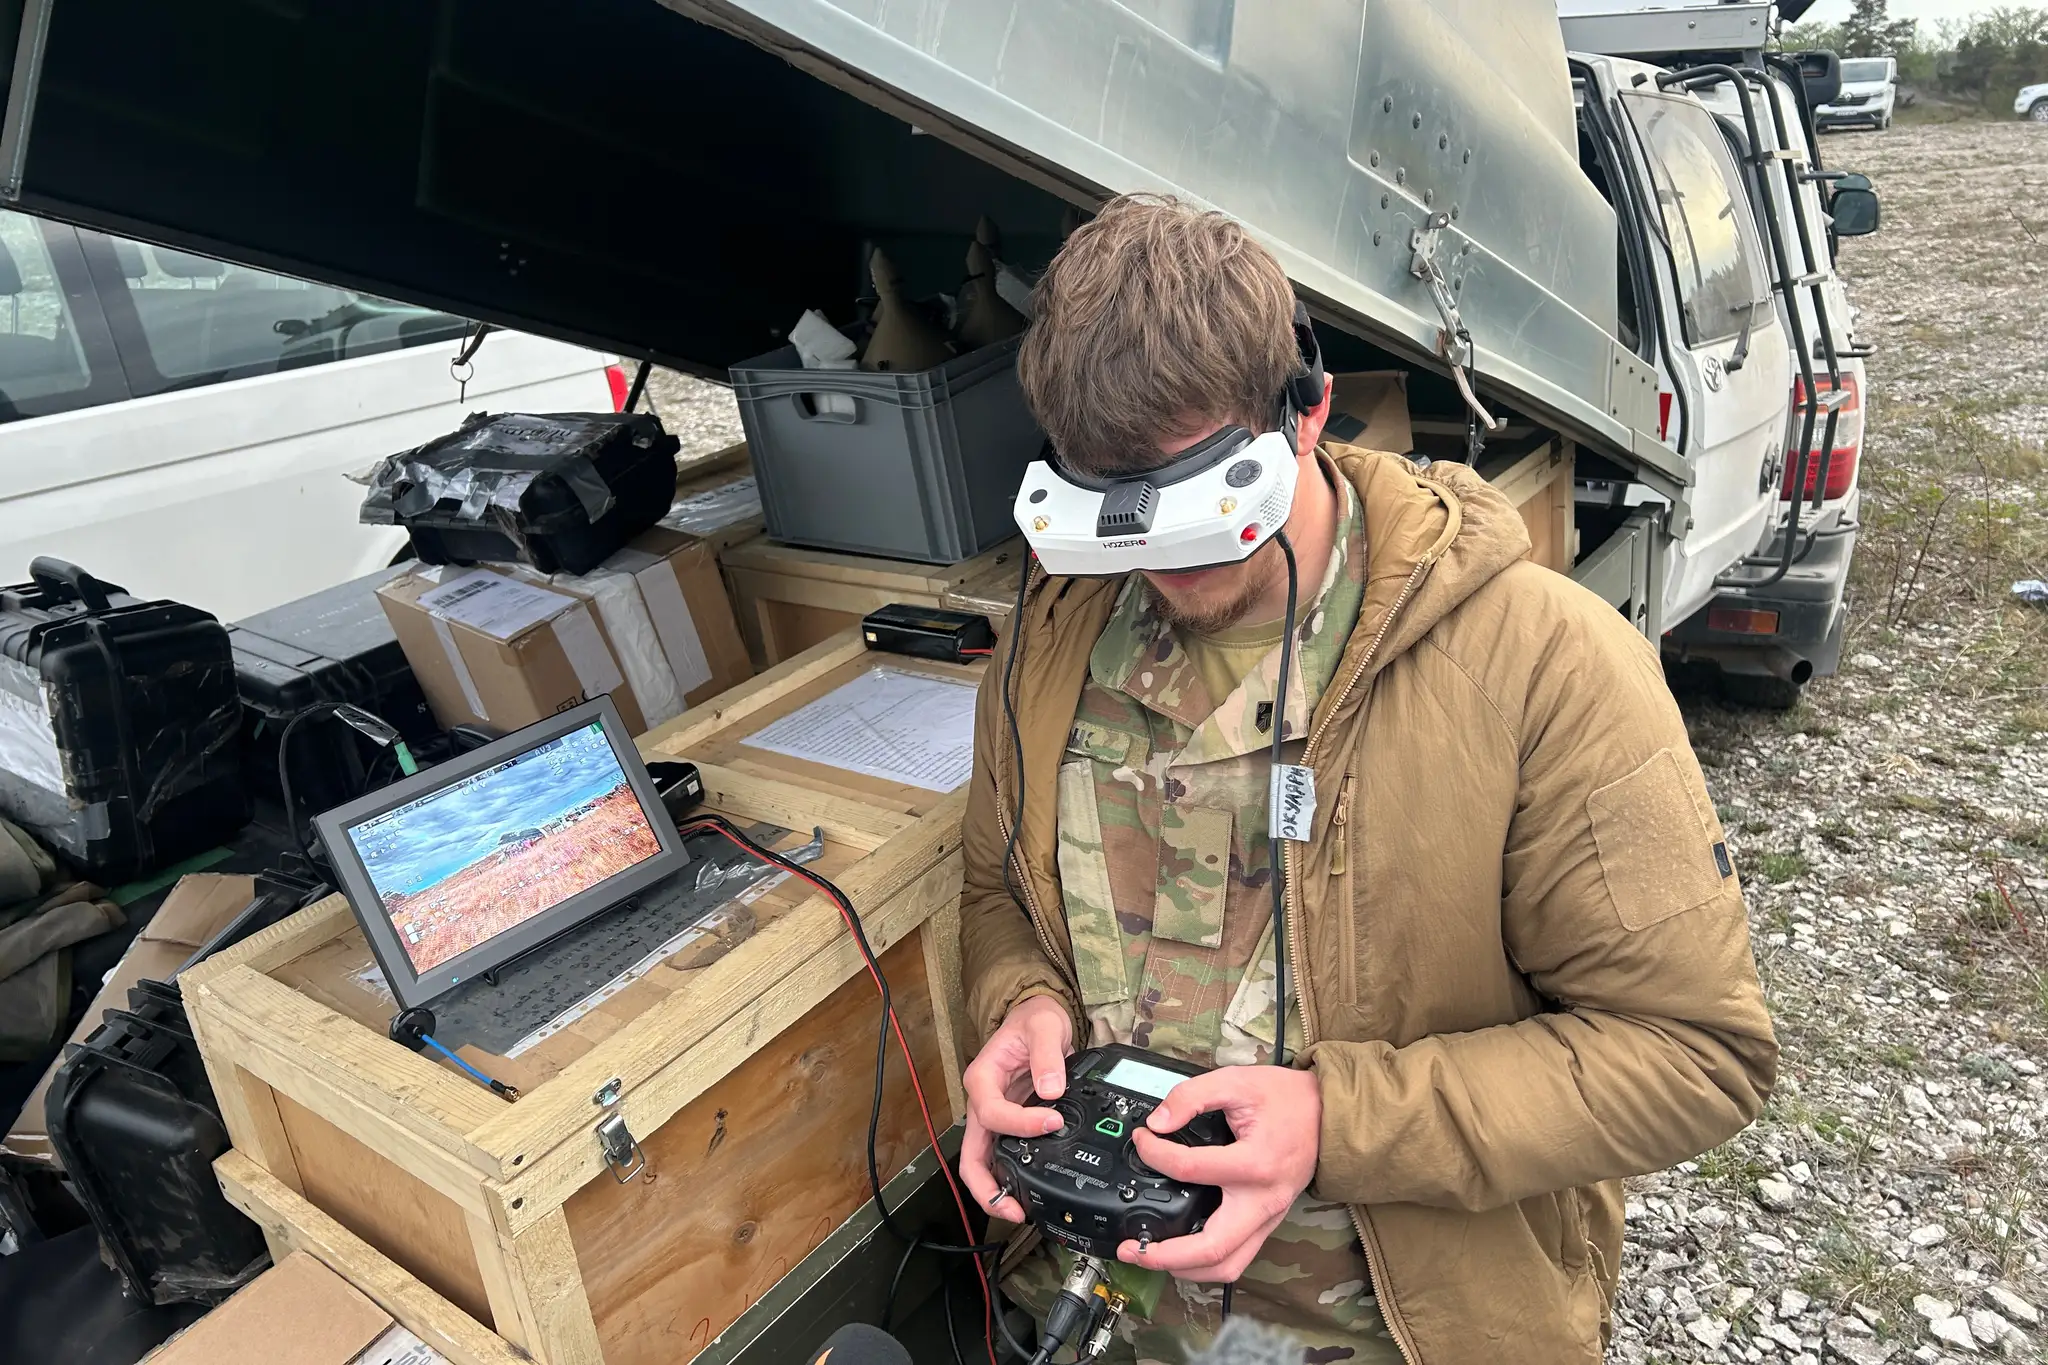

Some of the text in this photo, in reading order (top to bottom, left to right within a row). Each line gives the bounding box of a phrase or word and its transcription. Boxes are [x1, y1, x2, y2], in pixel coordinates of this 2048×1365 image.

[534, 744, 552, 757] AV3
[1281, 766, 1306, 839] ОКУЛЯРИ
[1074, 1150, 1101, 1166] TX12
